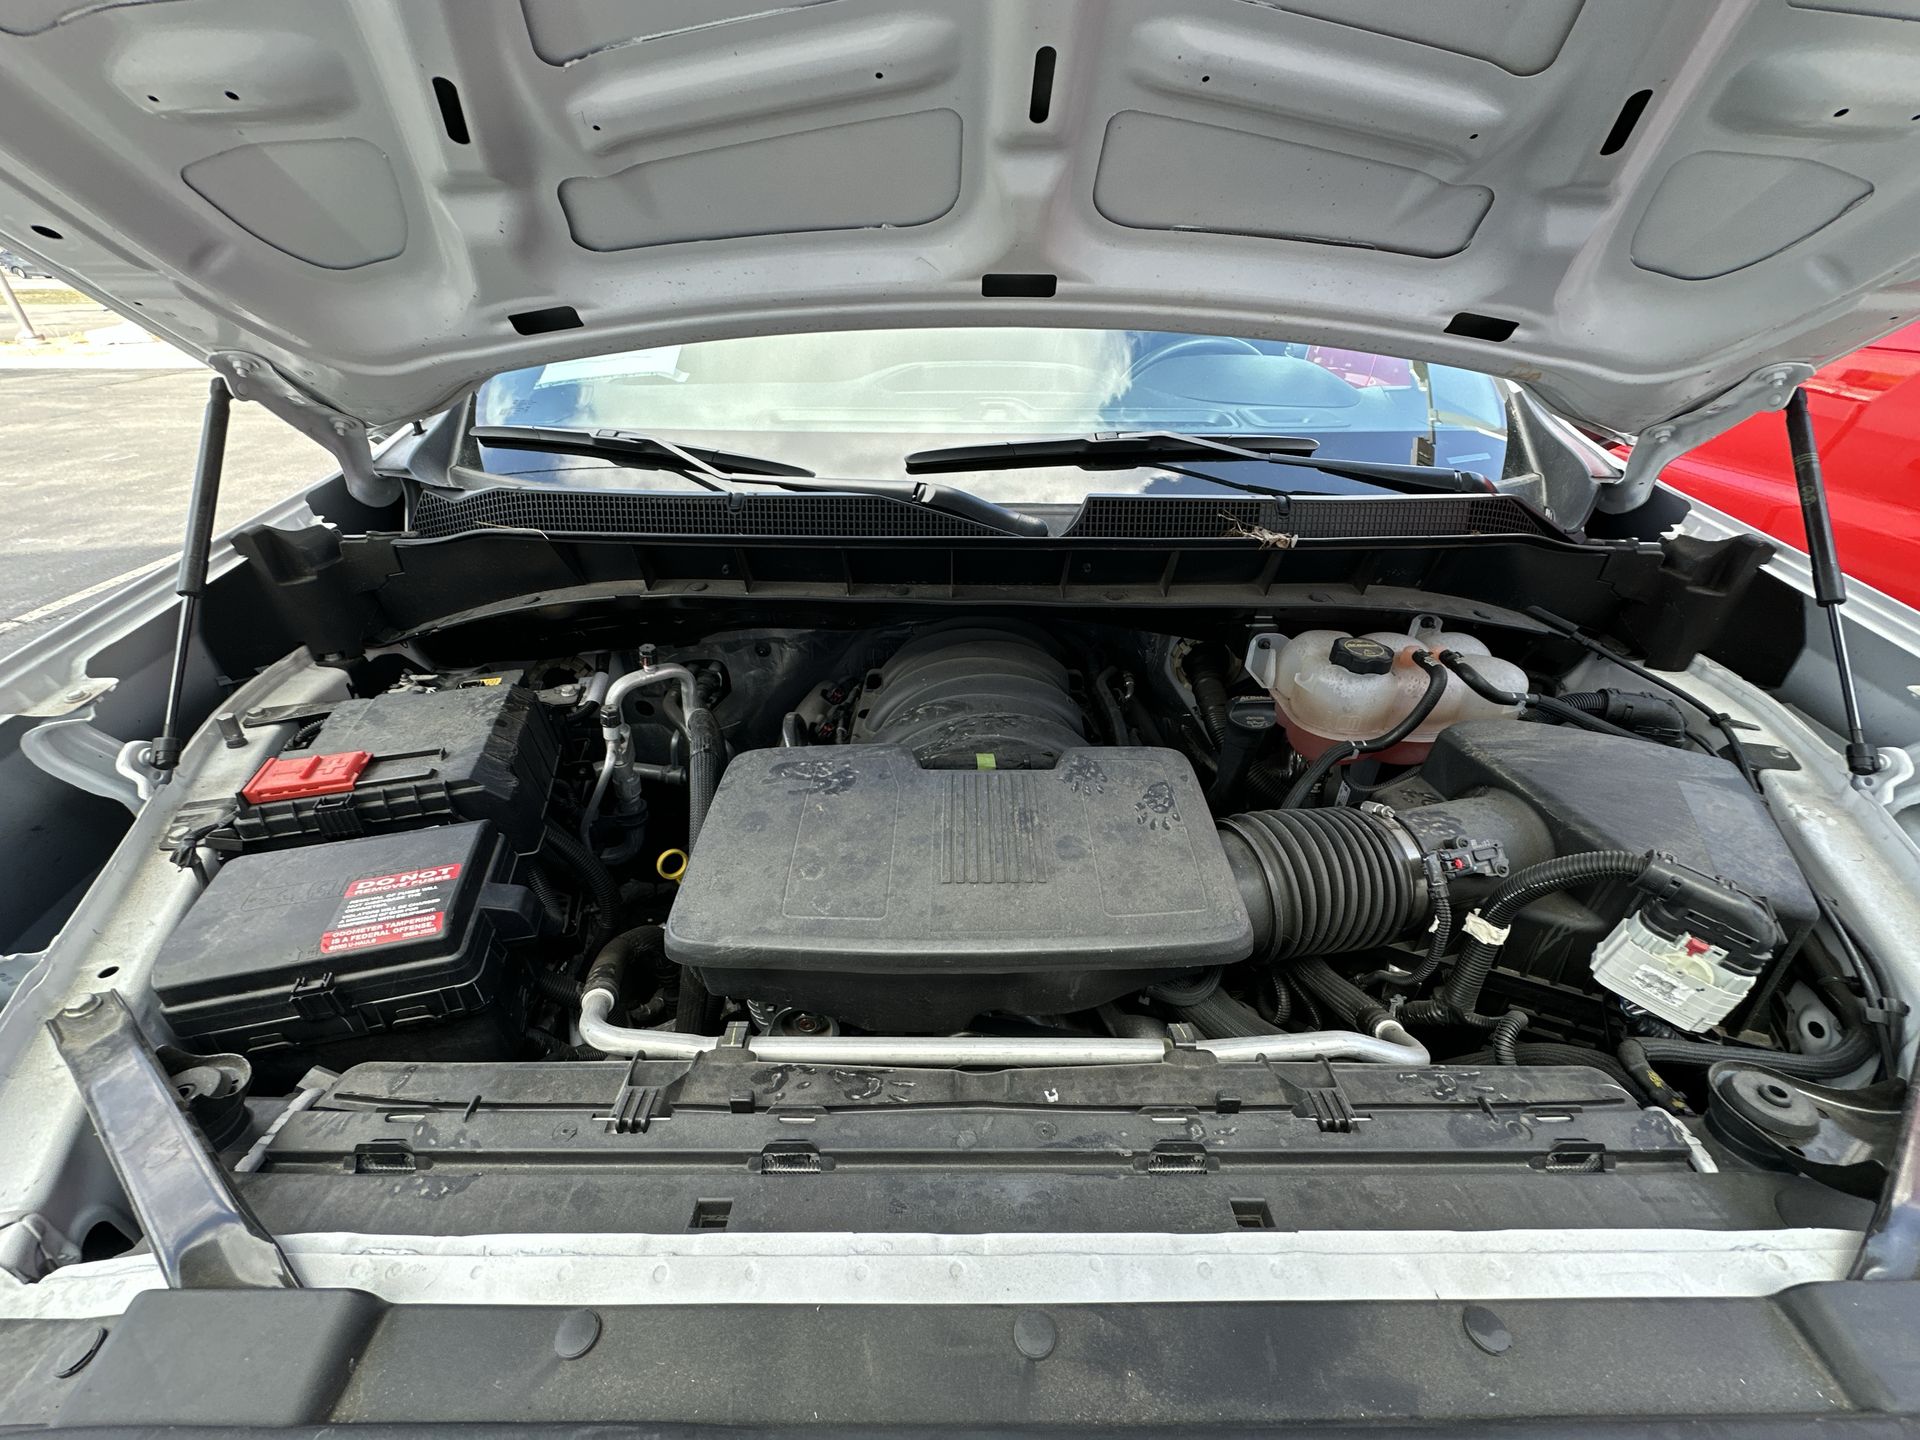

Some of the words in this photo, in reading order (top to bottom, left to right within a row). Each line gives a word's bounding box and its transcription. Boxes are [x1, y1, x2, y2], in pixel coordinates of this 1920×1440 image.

[354, 881, 408, 896] REMOVE
[411, 874, 451, 887] FUSES
[356, 878, 395, 890] DO
[399, 866, 455, 882] NOT
[332, 924, 384, 938] ODOMETER
[385, 914, 436, 929] TAMPERING
[342, 935, 349, 943] A
[350, 928, 390, 941] FEDERAL
[392, 921, 435, 933] OFFENSE.
